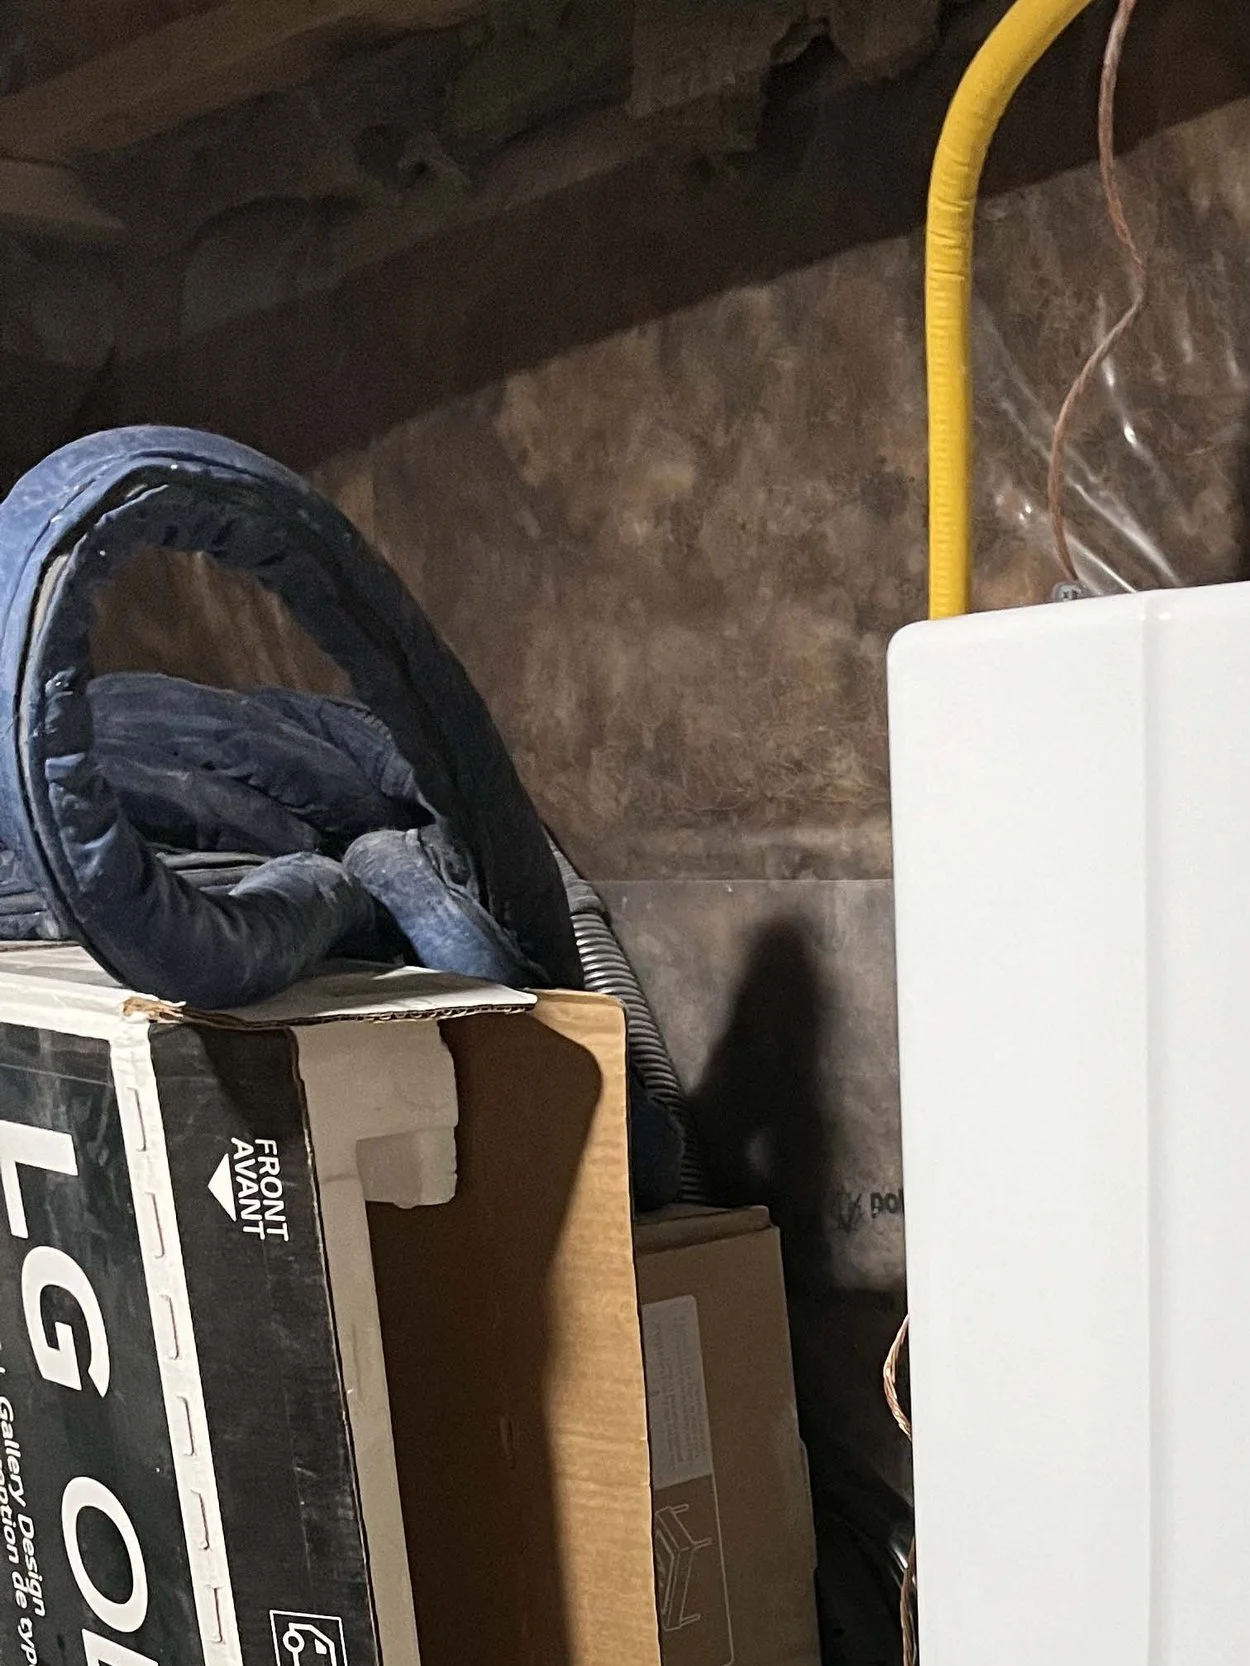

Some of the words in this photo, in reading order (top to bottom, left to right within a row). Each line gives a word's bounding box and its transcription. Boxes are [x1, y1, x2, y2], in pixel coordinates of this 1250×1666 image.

[231, 1137, 265, 1240] AVANT
[255, 1139, 289, 1241] FRONT
[0, 1119, 110, 1398] LG
[12, 1571, 27, 1608] de
[18, 1513, 46, 1617] Design
